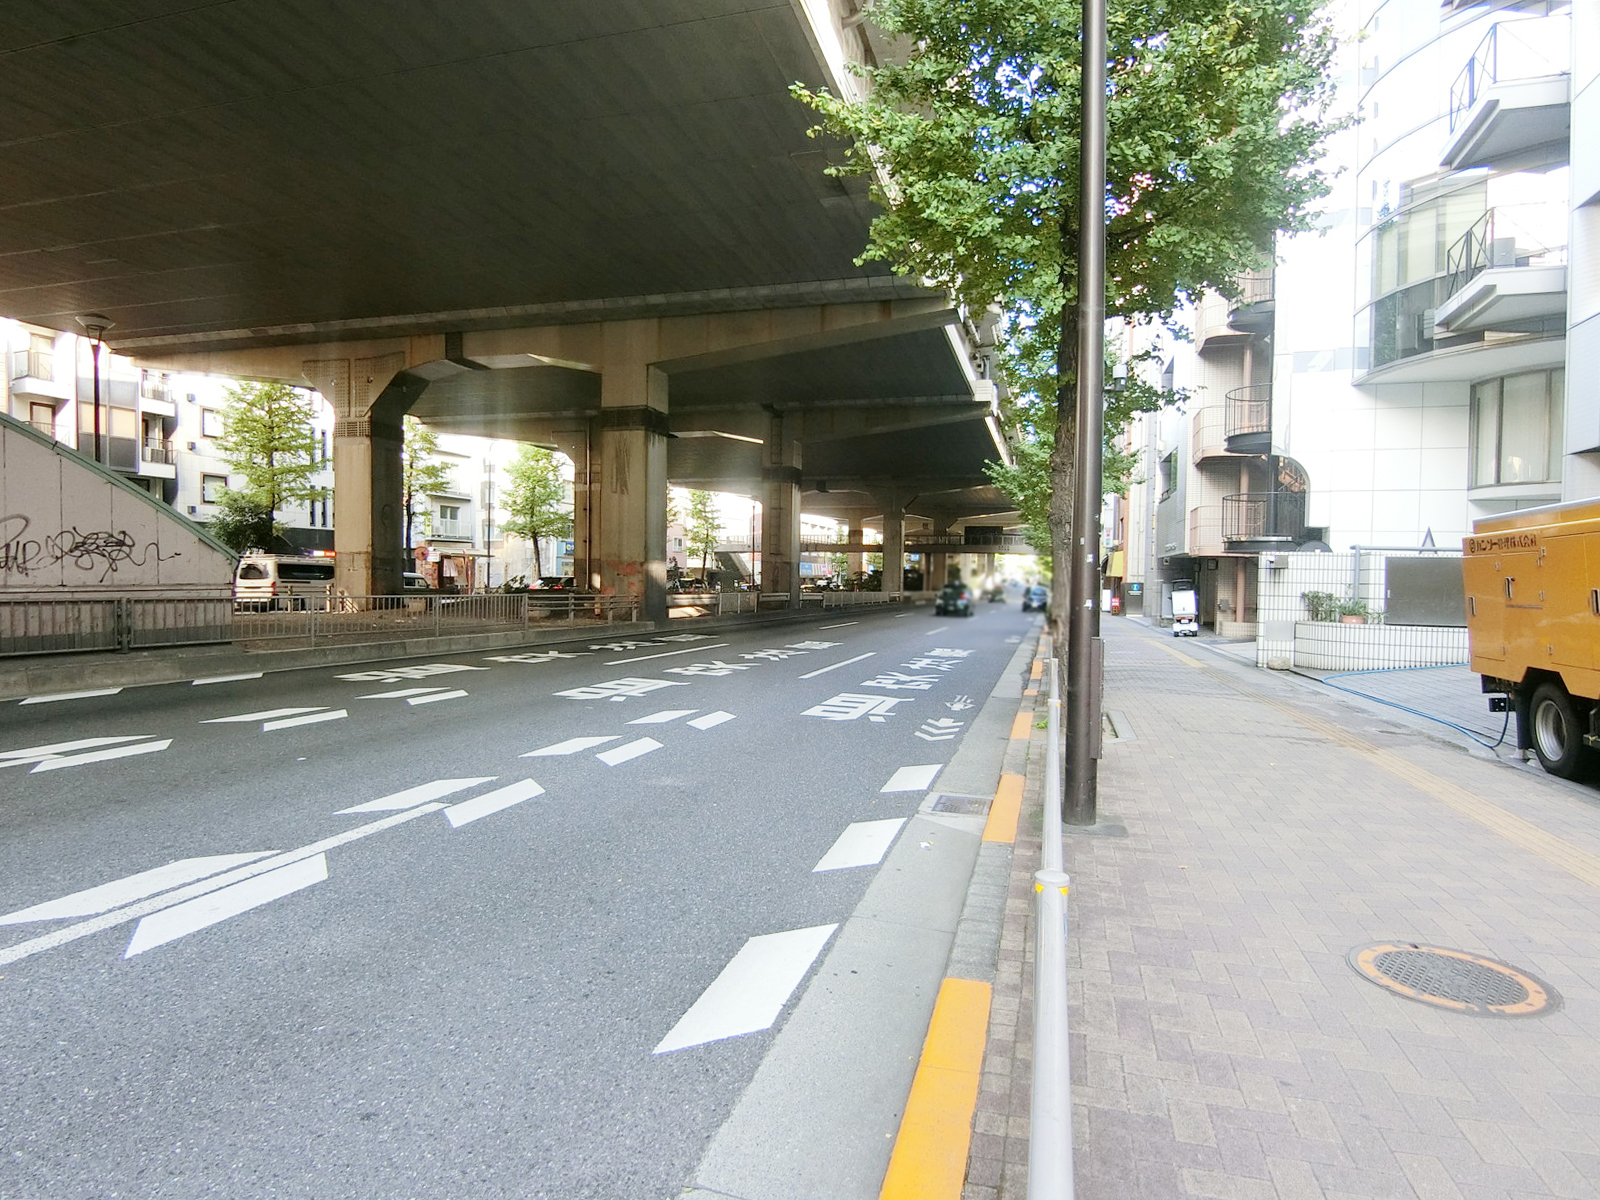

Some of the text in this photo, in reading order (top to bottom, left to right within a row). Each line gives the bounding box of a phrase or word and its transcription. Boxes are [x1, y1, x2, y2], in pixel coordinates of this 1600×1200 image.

[552, 640, 844, 702] 追突注意
[800, 647, 977, 723] 追突注意
